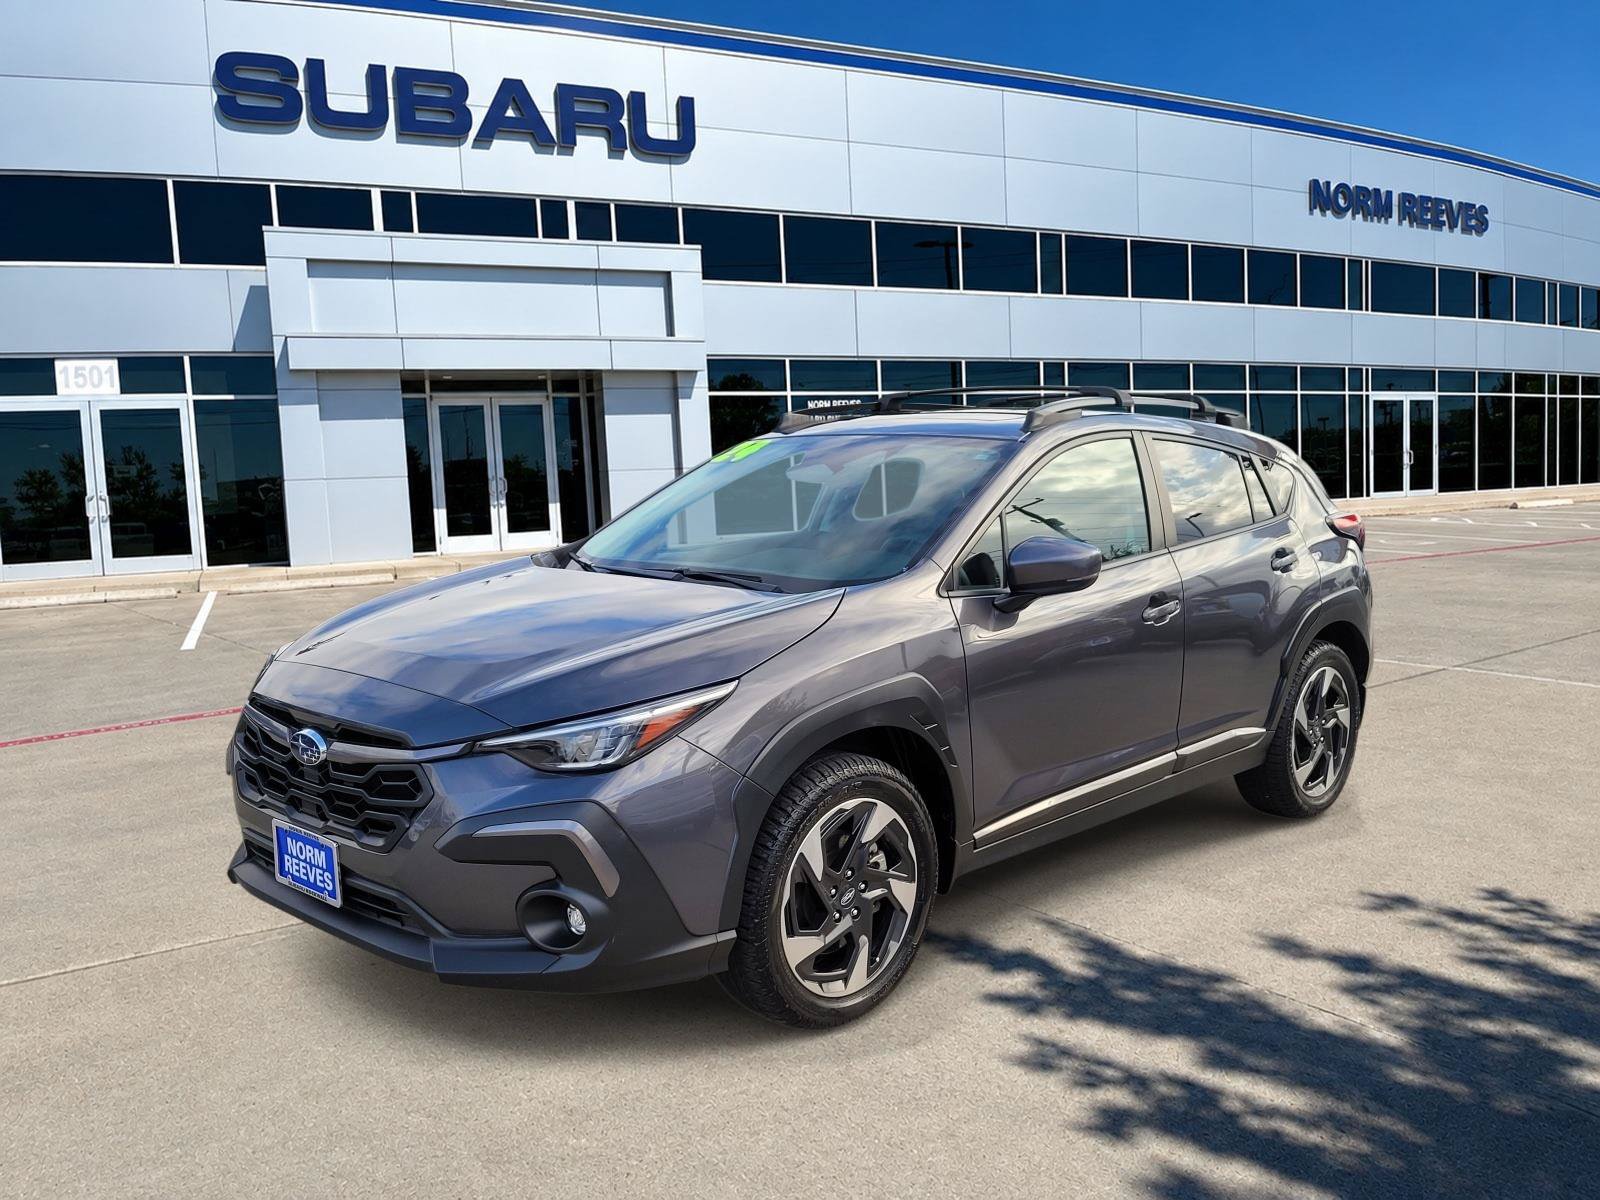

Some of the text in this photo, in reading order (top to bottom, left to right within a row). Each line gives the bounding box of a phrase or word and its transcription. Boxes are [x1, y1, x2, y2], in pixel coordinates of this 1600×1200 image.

[215, 51, 696, 155] SUBARU
[1309, 178, 1489, 234] NORM REEVES
[59, 365, 116, 389] 1501
[286, 837, 326, 870] NORM
[284, 854, 333, 891] REEVES
